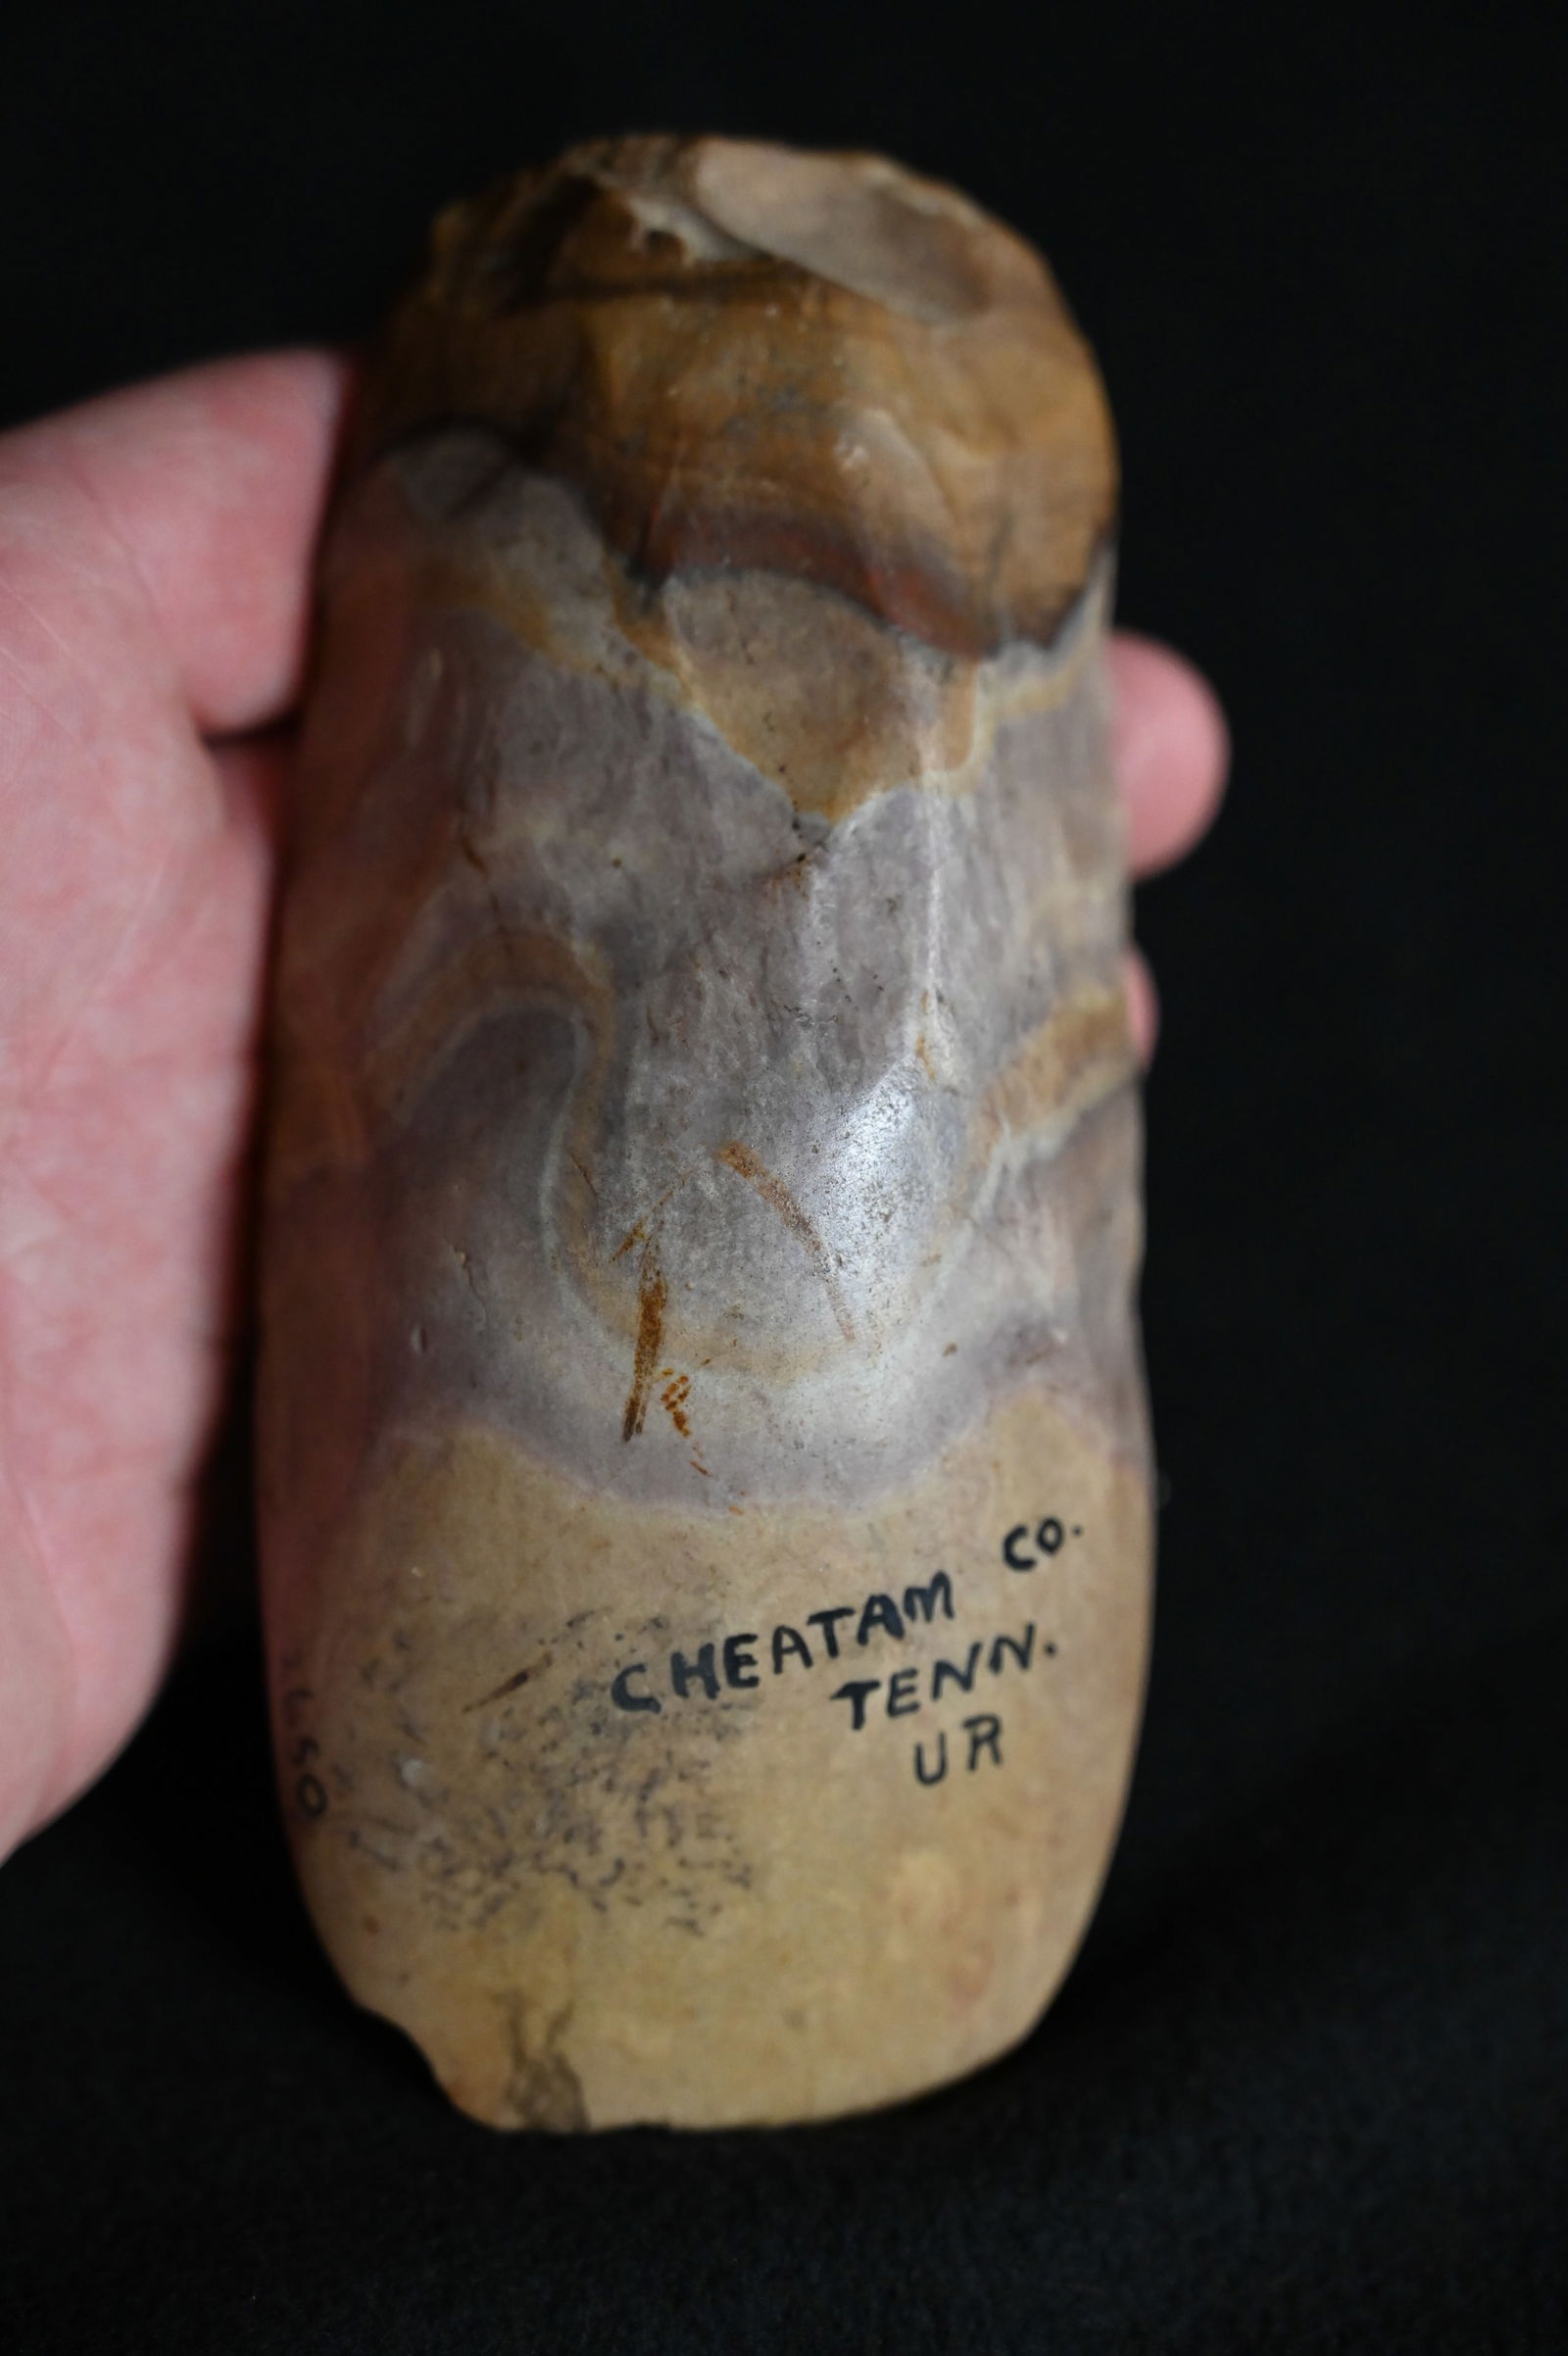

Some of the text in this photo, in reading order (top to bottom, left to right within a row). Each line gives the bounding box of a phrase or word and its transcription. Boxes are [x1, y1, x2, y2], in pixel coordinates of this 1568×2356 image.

[611, 1516, 1082, 1714] CHEATAM CO.
[829, 1622, 1056, 1730] TENN.
[913, 1714, 1003, 1787] UR
